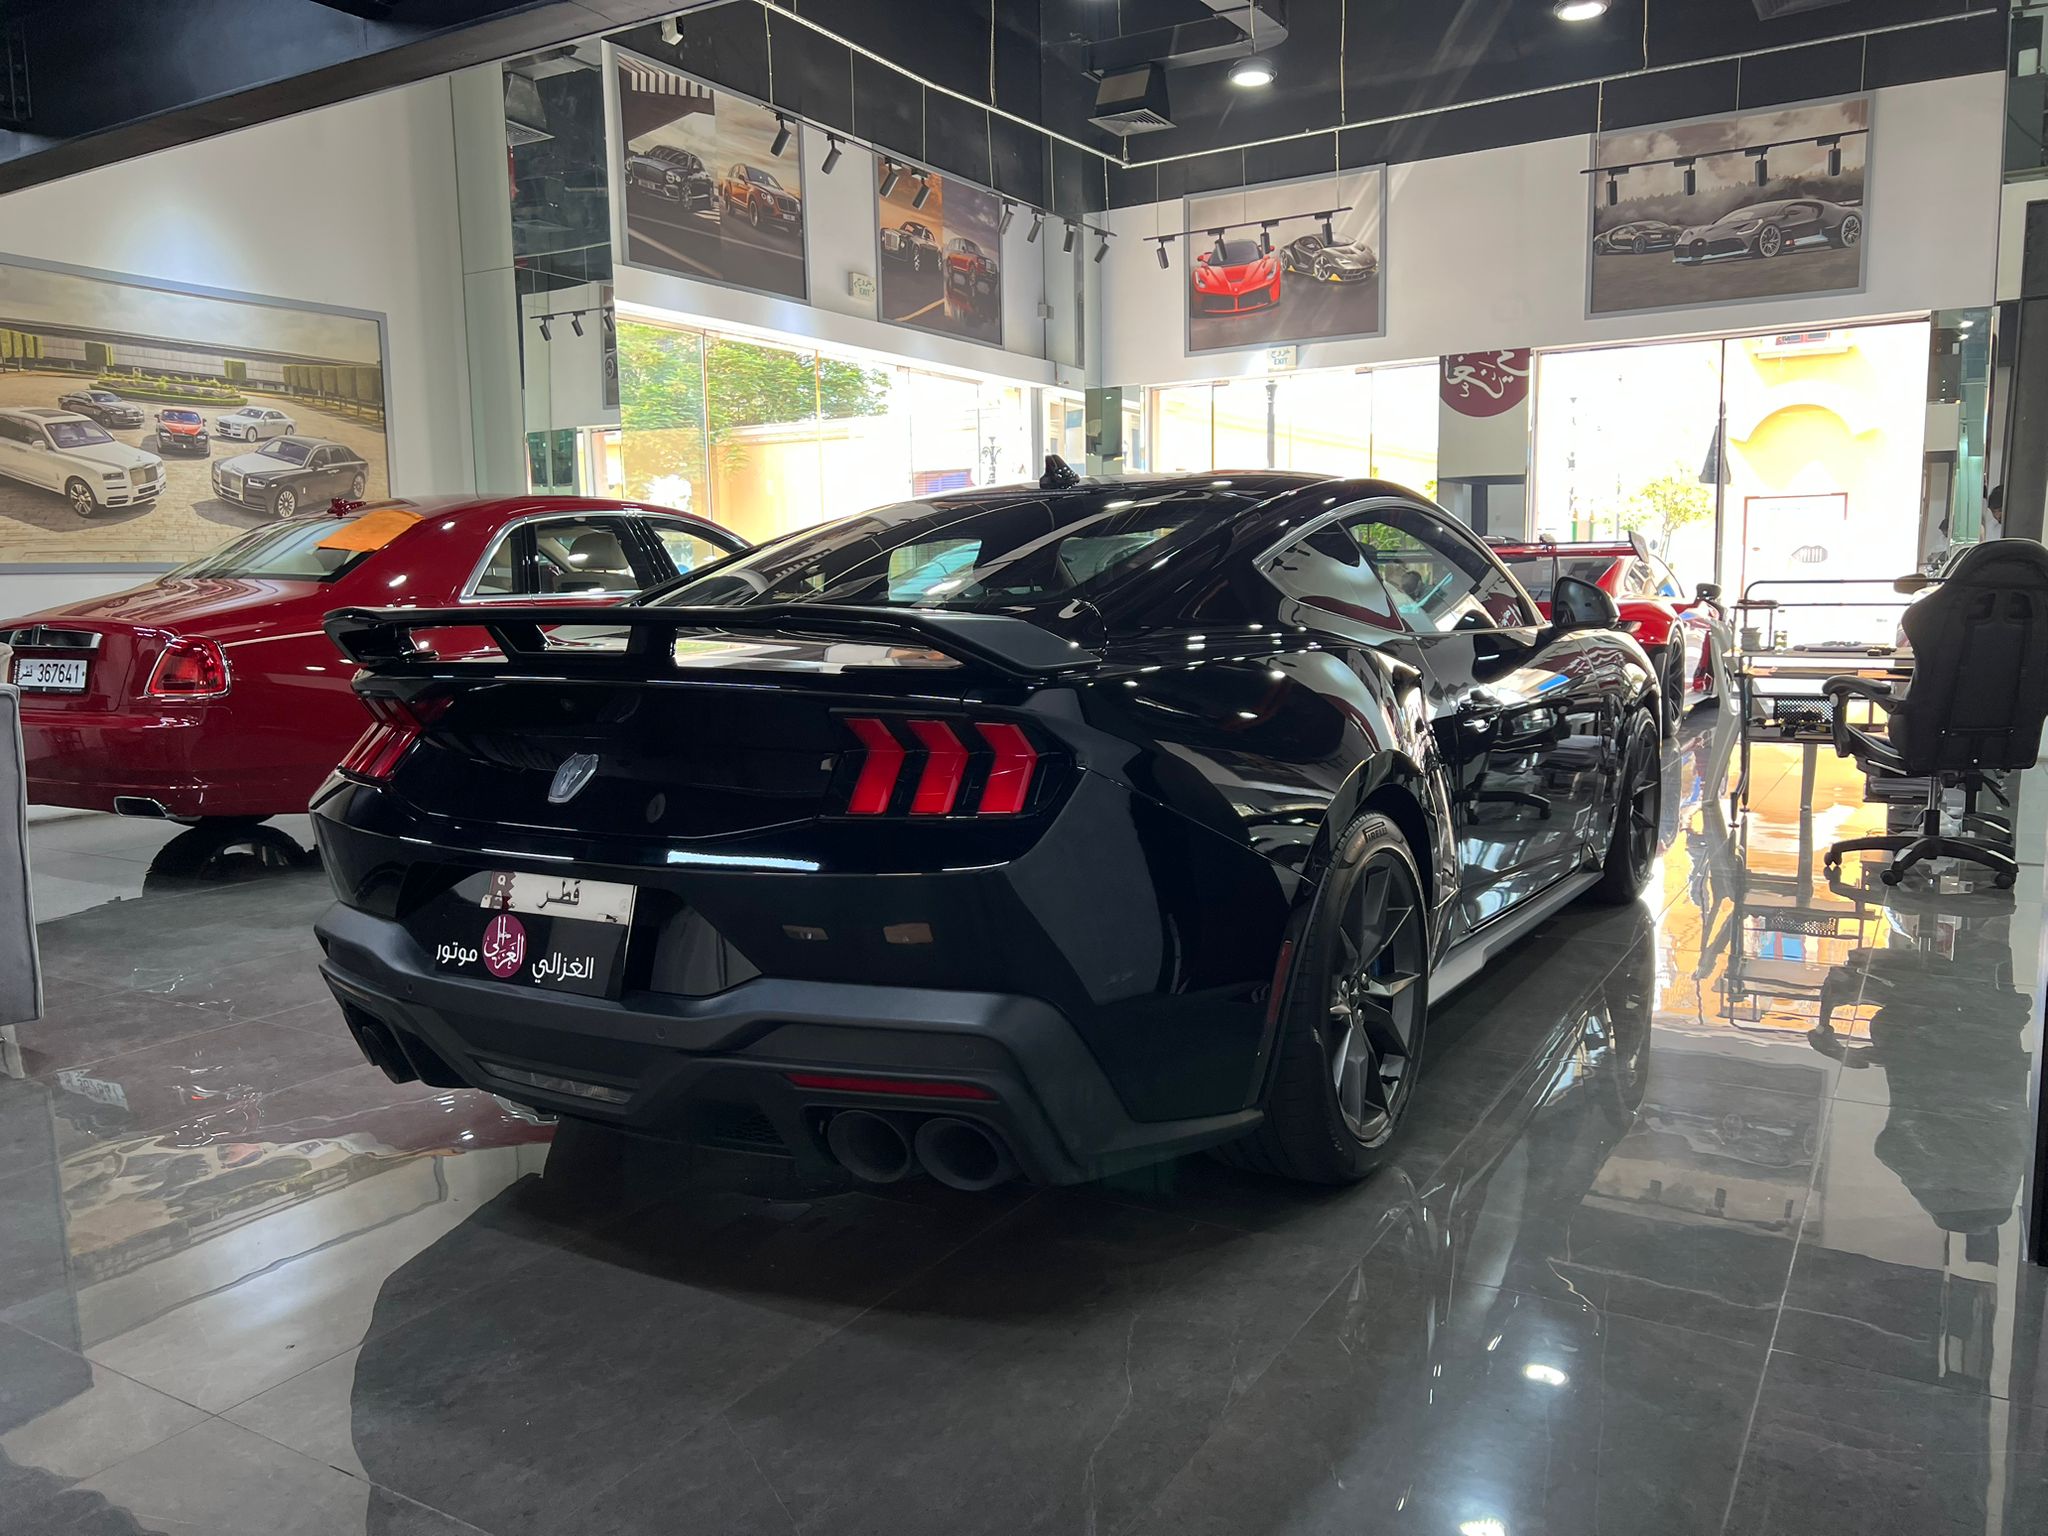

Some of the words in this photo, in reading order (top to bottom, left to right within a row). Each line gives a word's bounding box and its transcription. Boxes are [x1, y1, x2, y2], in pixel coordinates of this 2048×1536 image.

[859, 287, 871, 297] EXIT
[1273, 357, 1288, 366] EXIT
[37, 663, 79, 684] 367641
[1362, 821, 1388, 843] PIRELLI
[536, 879, 581, 910] قطر
[436, 941, 478, 967] موتور
[532, 951, 595, 984] الغزالي
